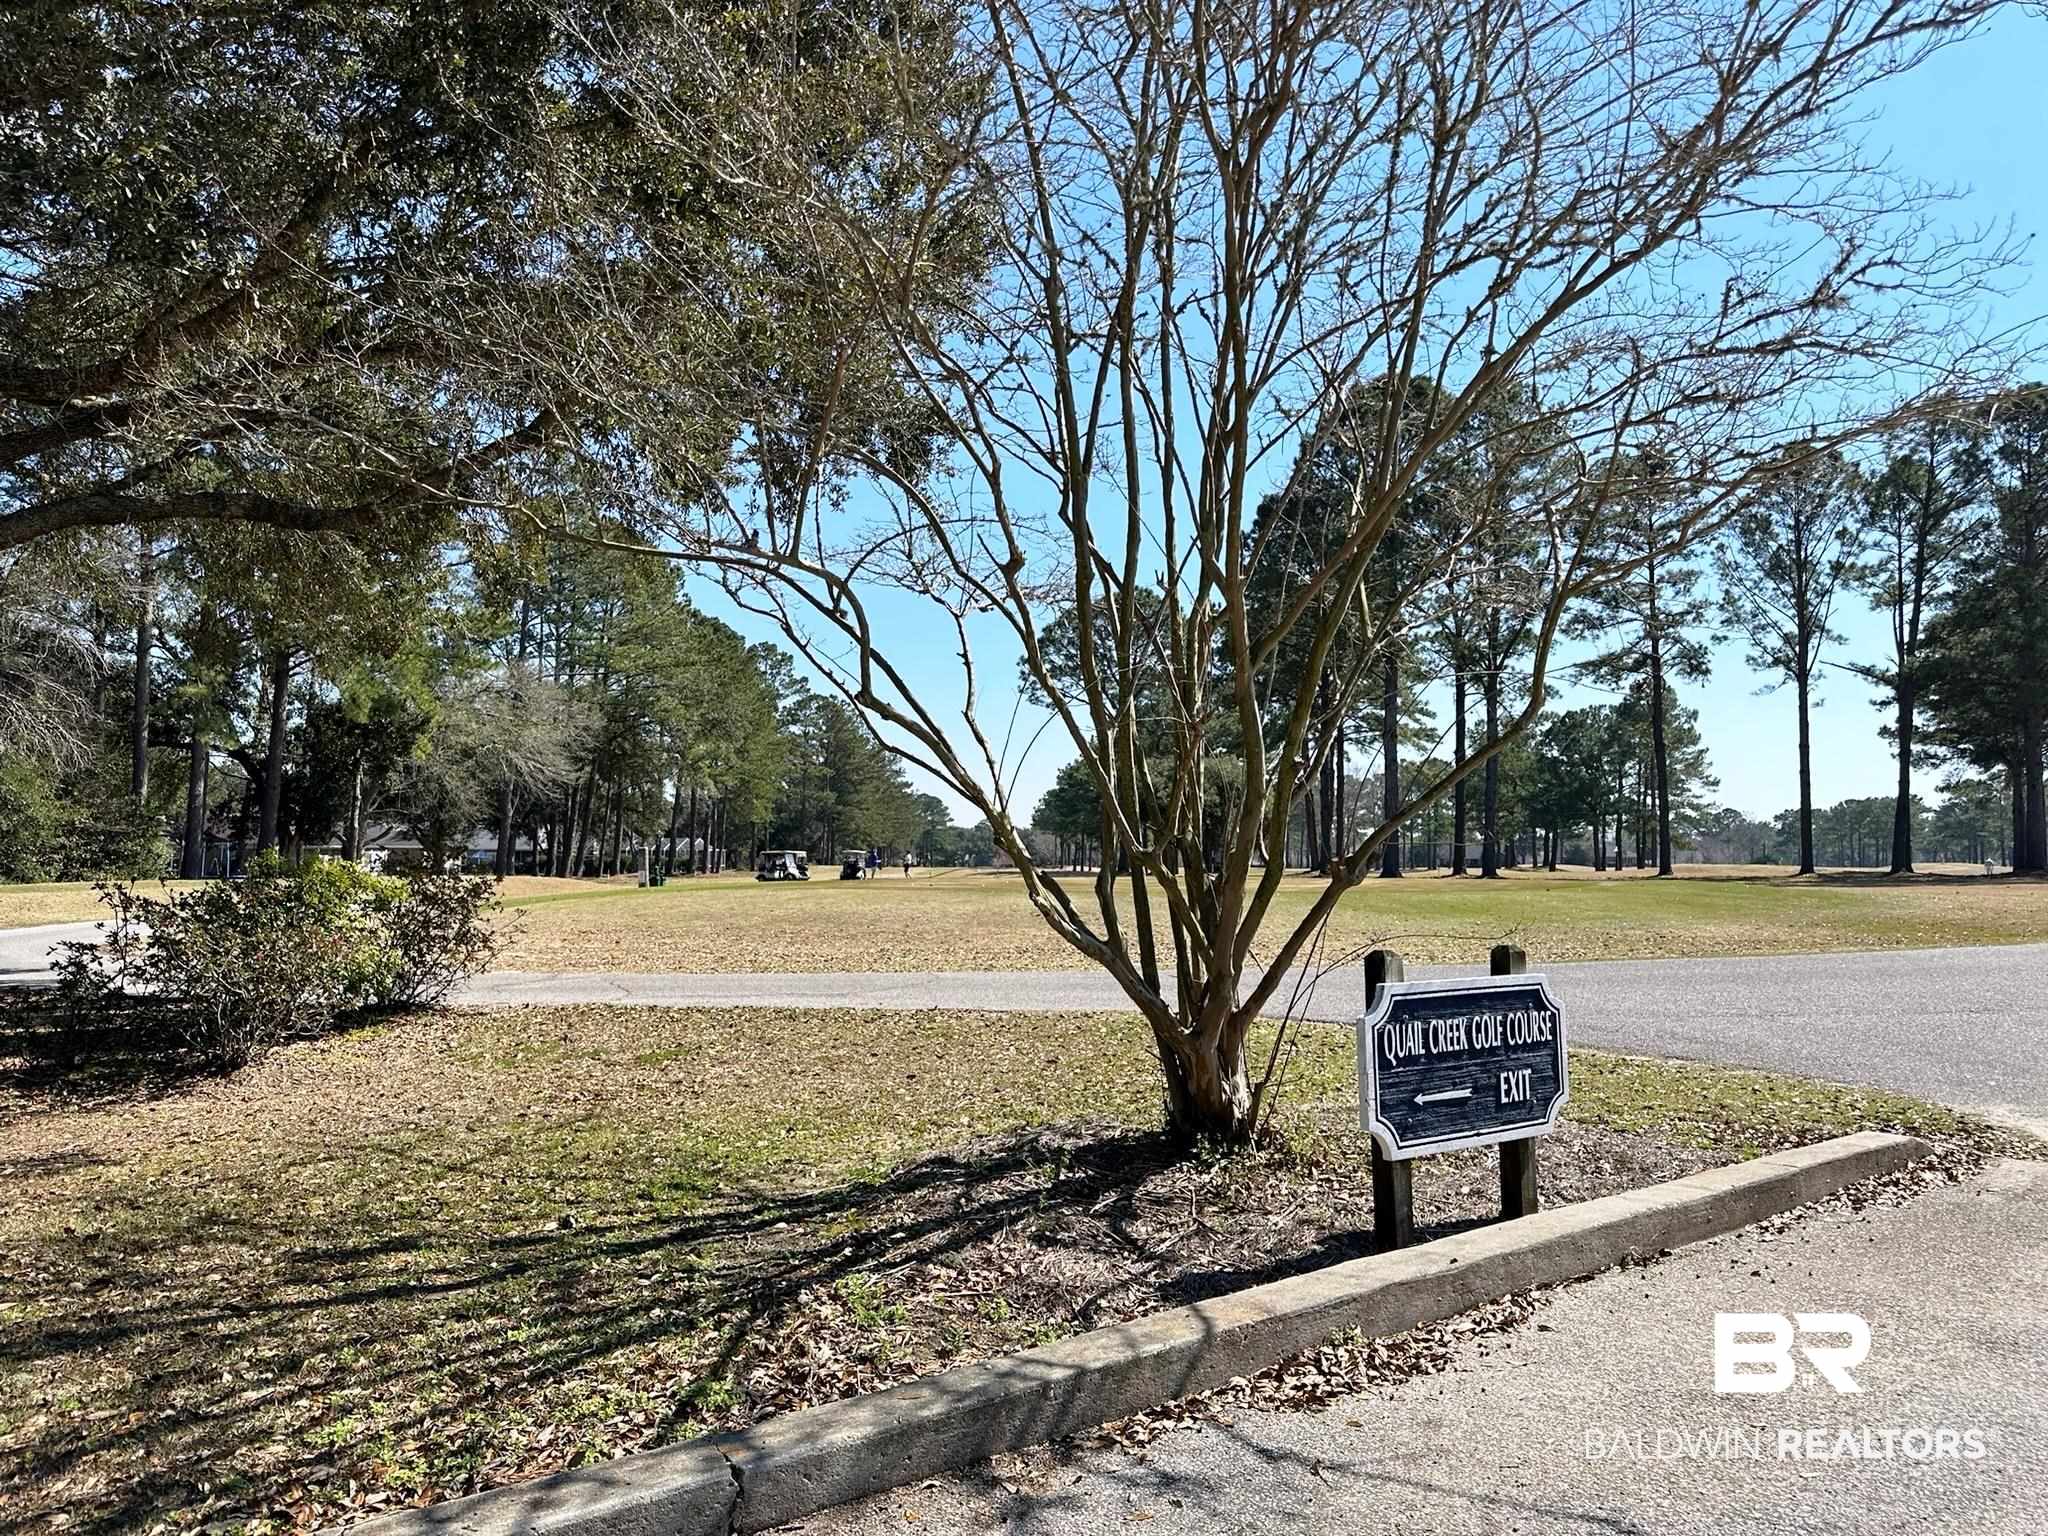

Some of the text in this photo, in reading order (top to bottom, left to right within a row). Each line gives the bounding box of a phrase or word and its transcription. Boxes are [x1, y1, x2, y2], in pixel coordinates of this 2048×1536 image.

[1384, 1010, 1553, 1066] QUAIL CREEK GOLF COURSE
[1500, 1068, 1532, 1104] EXIT
